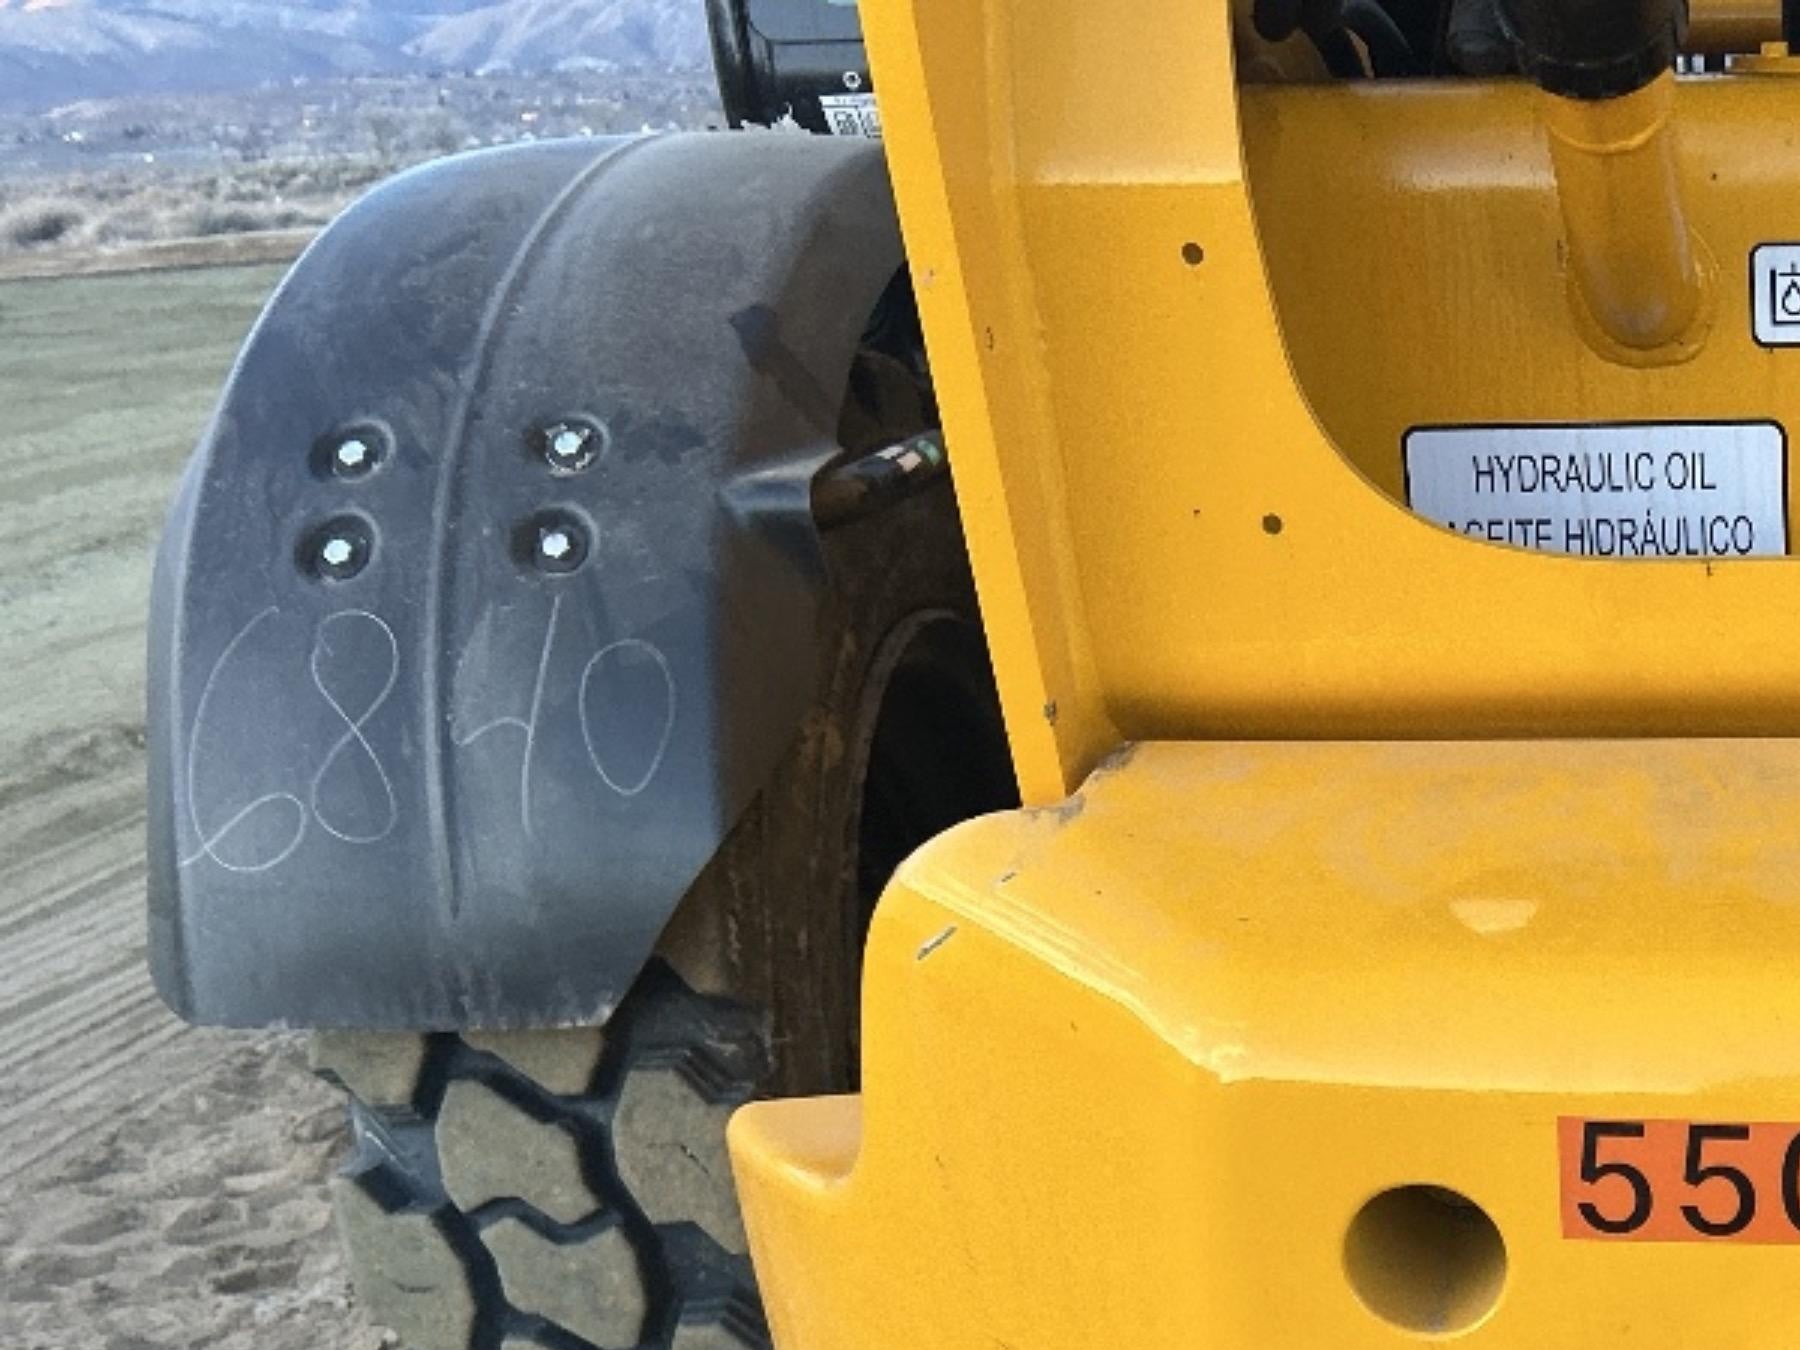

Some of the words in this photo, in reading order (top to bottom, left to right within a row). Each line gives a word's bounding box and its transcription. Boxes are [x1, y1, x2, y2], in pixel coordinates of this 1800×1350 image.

[1472, 452, 1655, 494] HYDRAULIC
[1664, 451, 1717, 490] OIL
[1565, 509, 1754, 556] HIDRÁULICO
